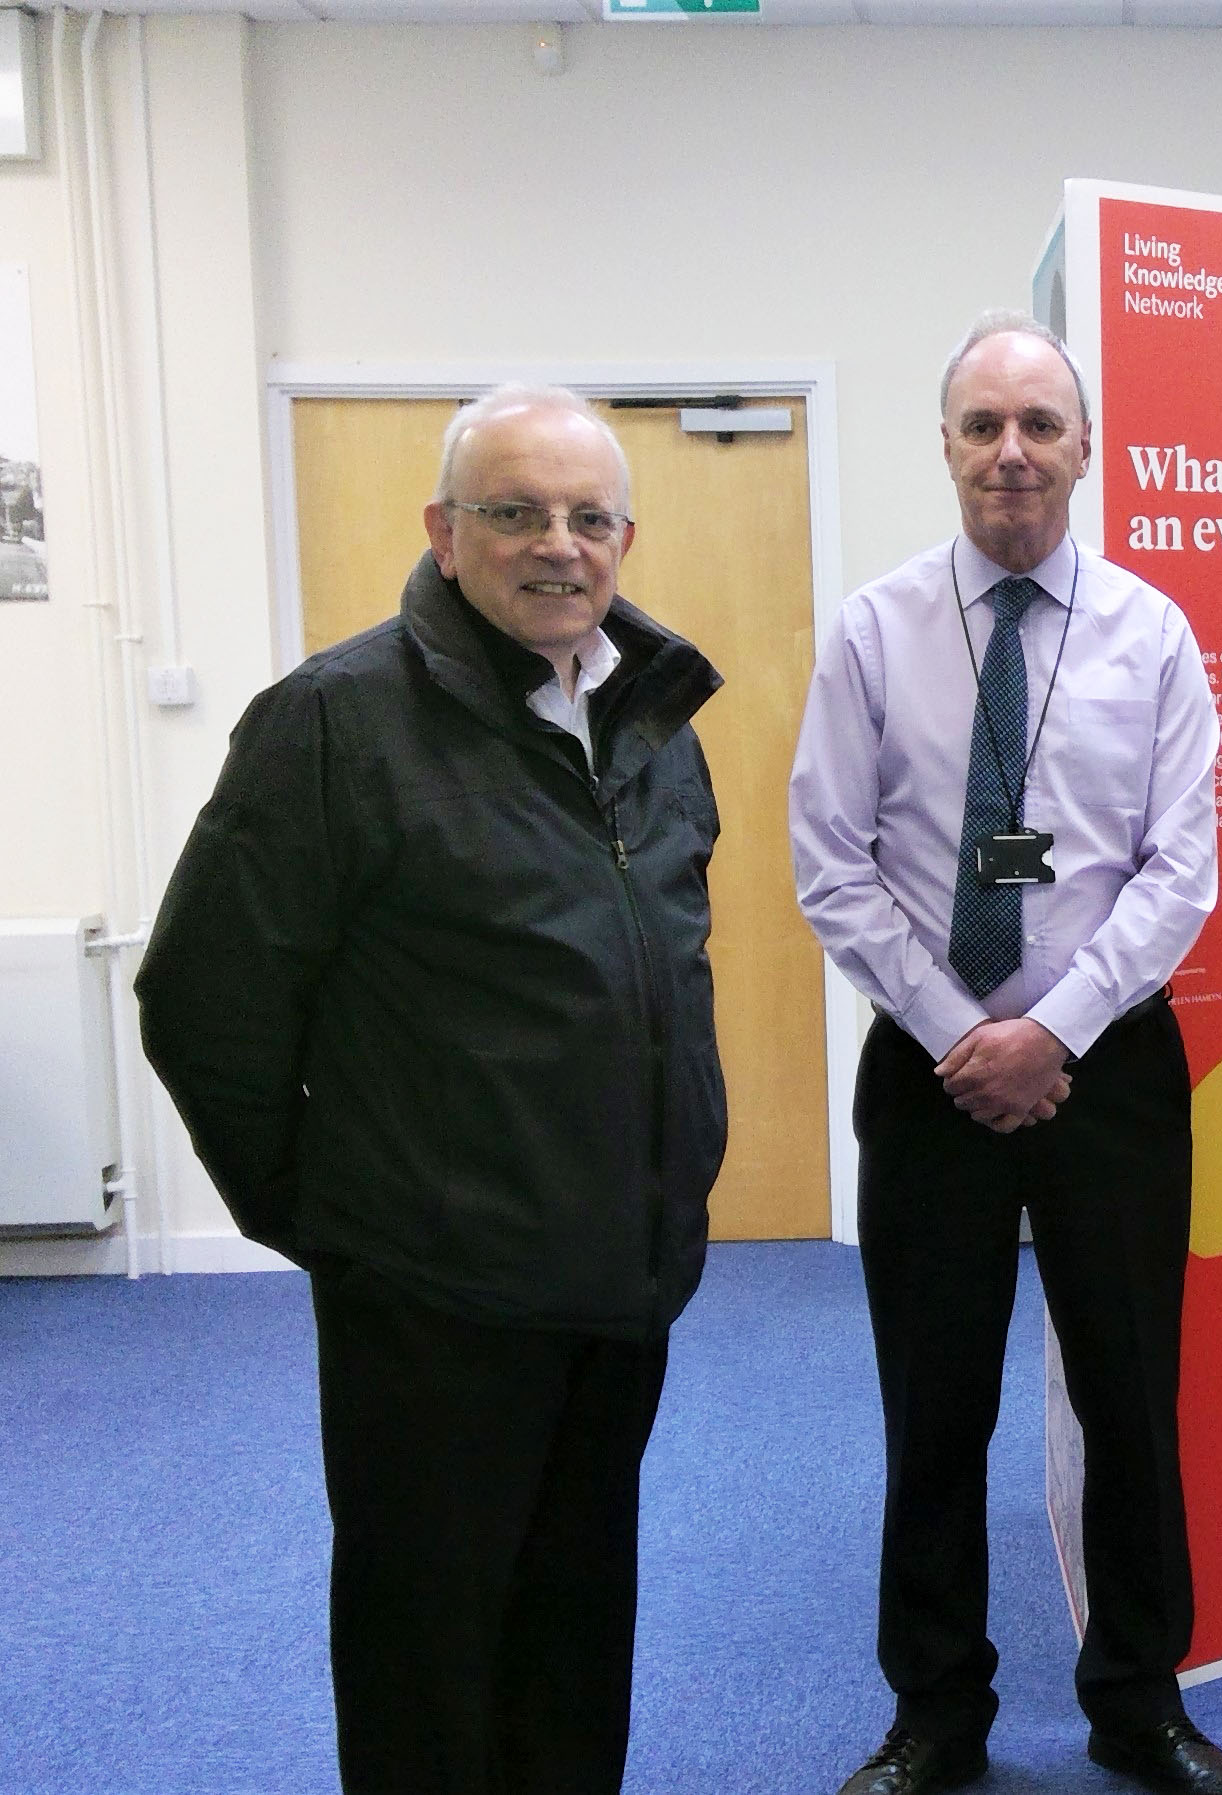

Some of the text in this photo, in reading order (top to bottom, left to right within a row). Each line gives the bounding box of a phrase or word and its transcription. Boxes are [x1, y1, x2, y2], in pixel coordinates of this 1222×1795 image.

[1124, 232, 1181, 266] Living
[1124, 290, 1204, 320] Network
[1129, 516, 1183, 551] an
[1202, 652, 1217, 663] es
[1208, 673, 1219, 684] s.
